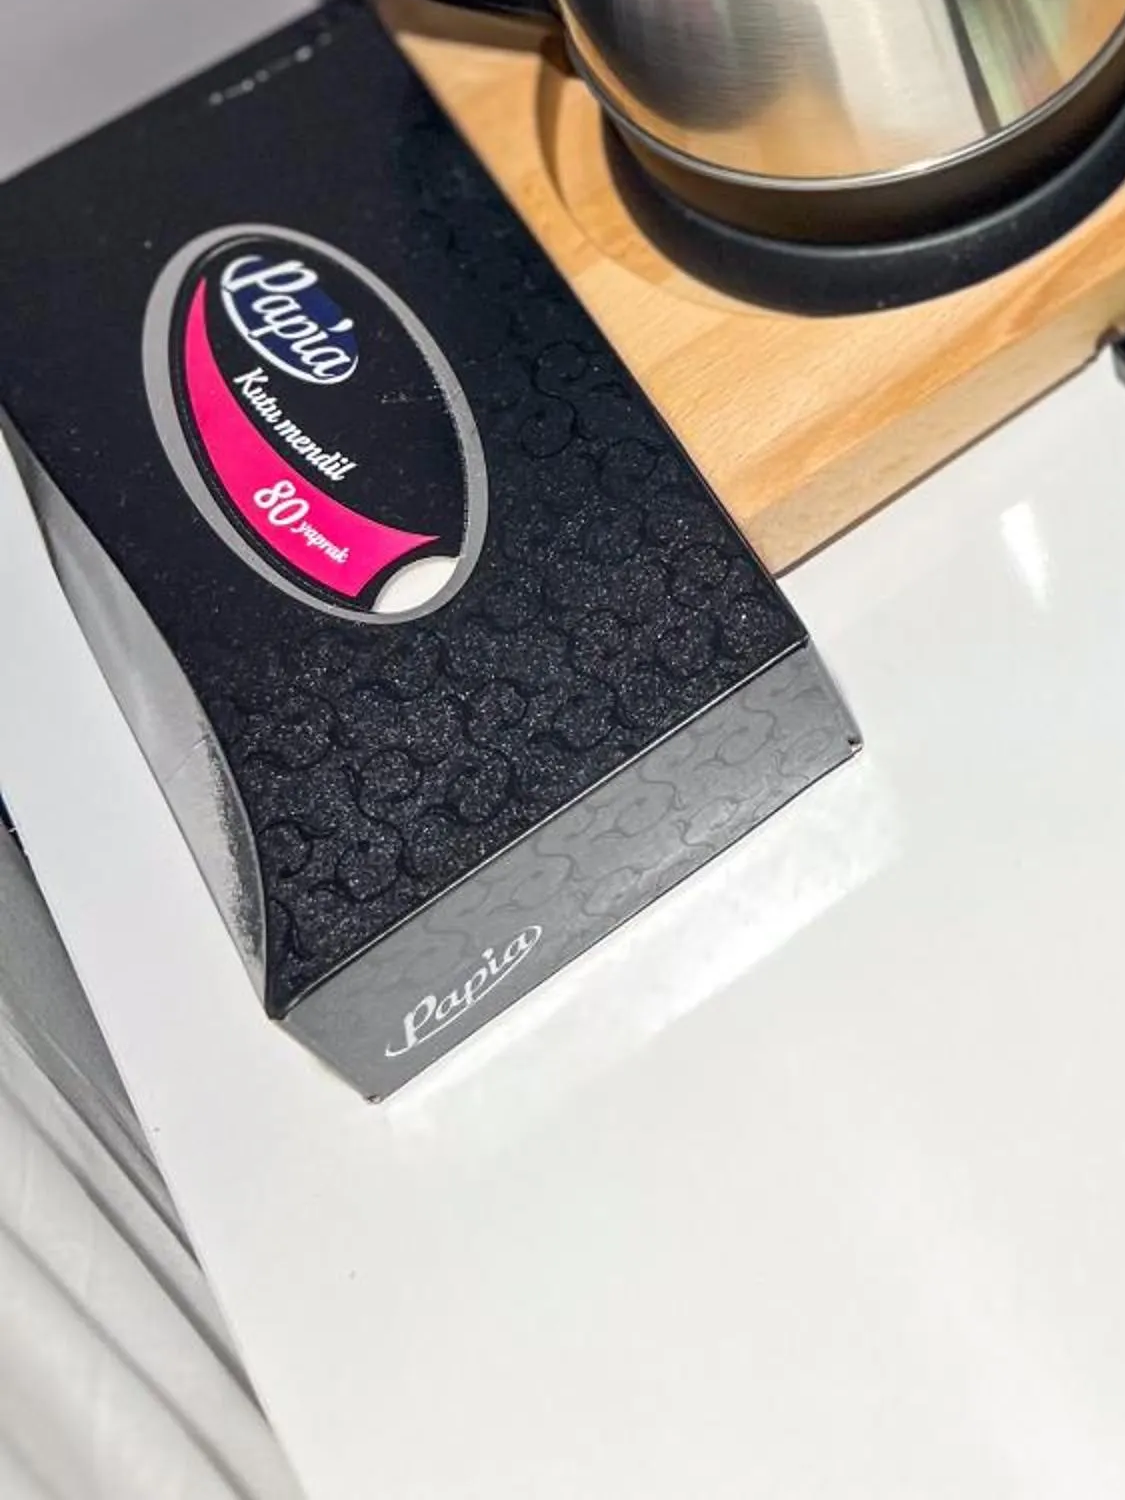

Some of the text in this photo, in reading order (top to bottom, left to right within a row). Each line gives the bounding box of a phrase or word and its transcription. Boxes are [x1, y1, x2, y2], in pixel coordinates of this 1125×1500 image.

[221, 255, 358, 385] Papia
[233, 367, 357, 481] Kutu mendil
[253, 479, 350, 564] 80 yaprak
[384, 925, 543, 1057] Papia
